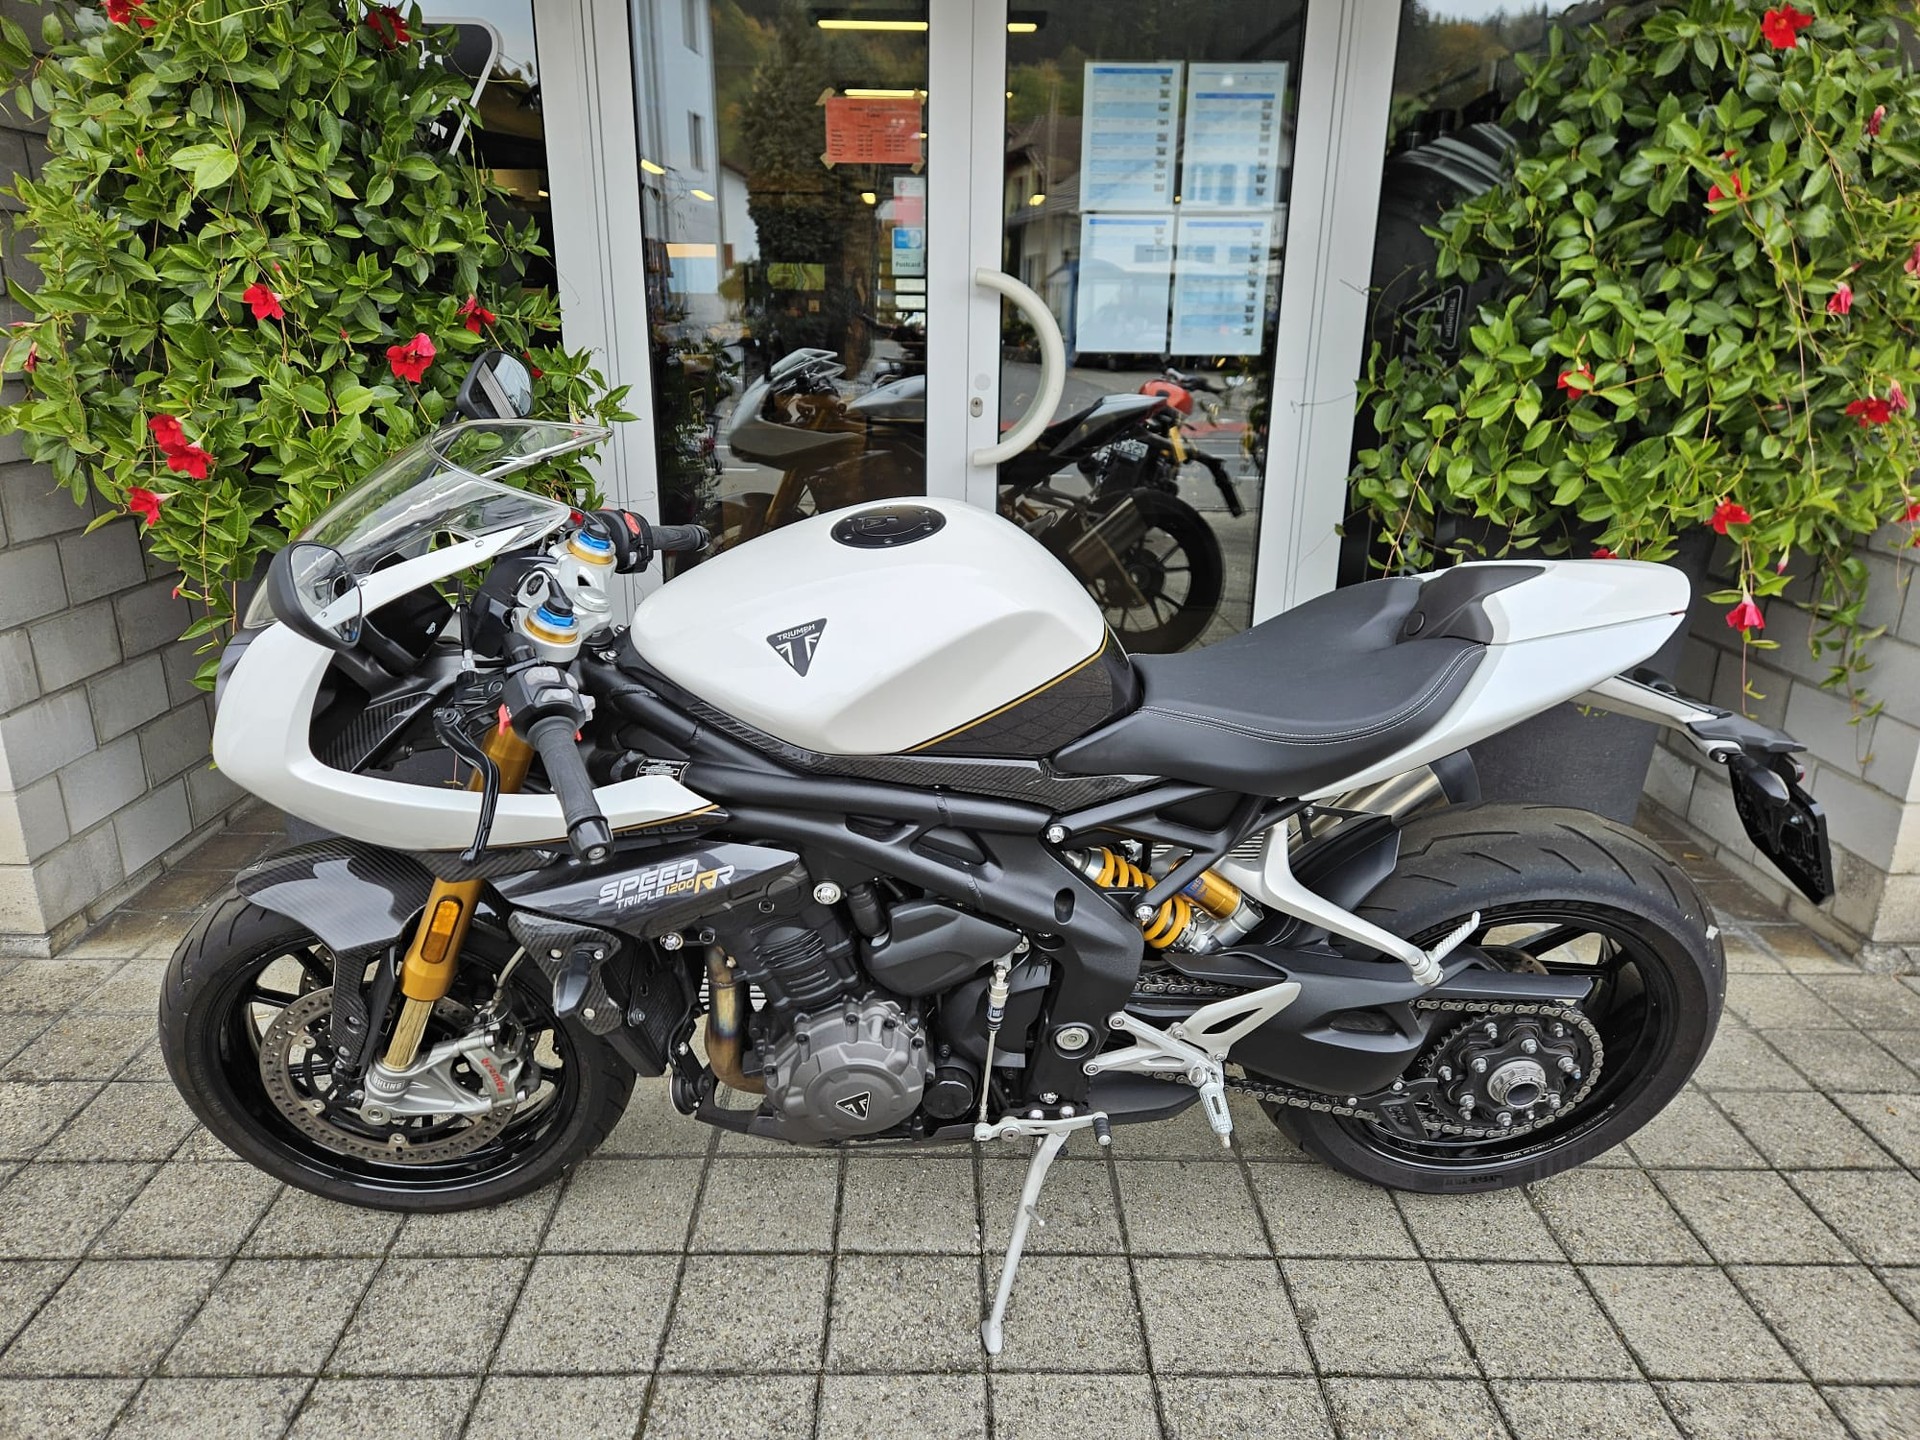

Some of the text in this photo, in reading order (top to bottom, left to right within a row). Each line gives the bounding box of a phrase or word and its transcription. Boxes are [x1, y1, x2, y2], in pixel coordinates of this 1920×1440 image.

[895, 260, 921, 268] Postcard
[776, 623, 815, 641] TRIUMPH
[599, 859, 699, 905] SPEED
[615, 886, 666, 910] TRIPLE
[665, 878, 695, 895] 1200
[481, 1057, 506, 1094] brembo
